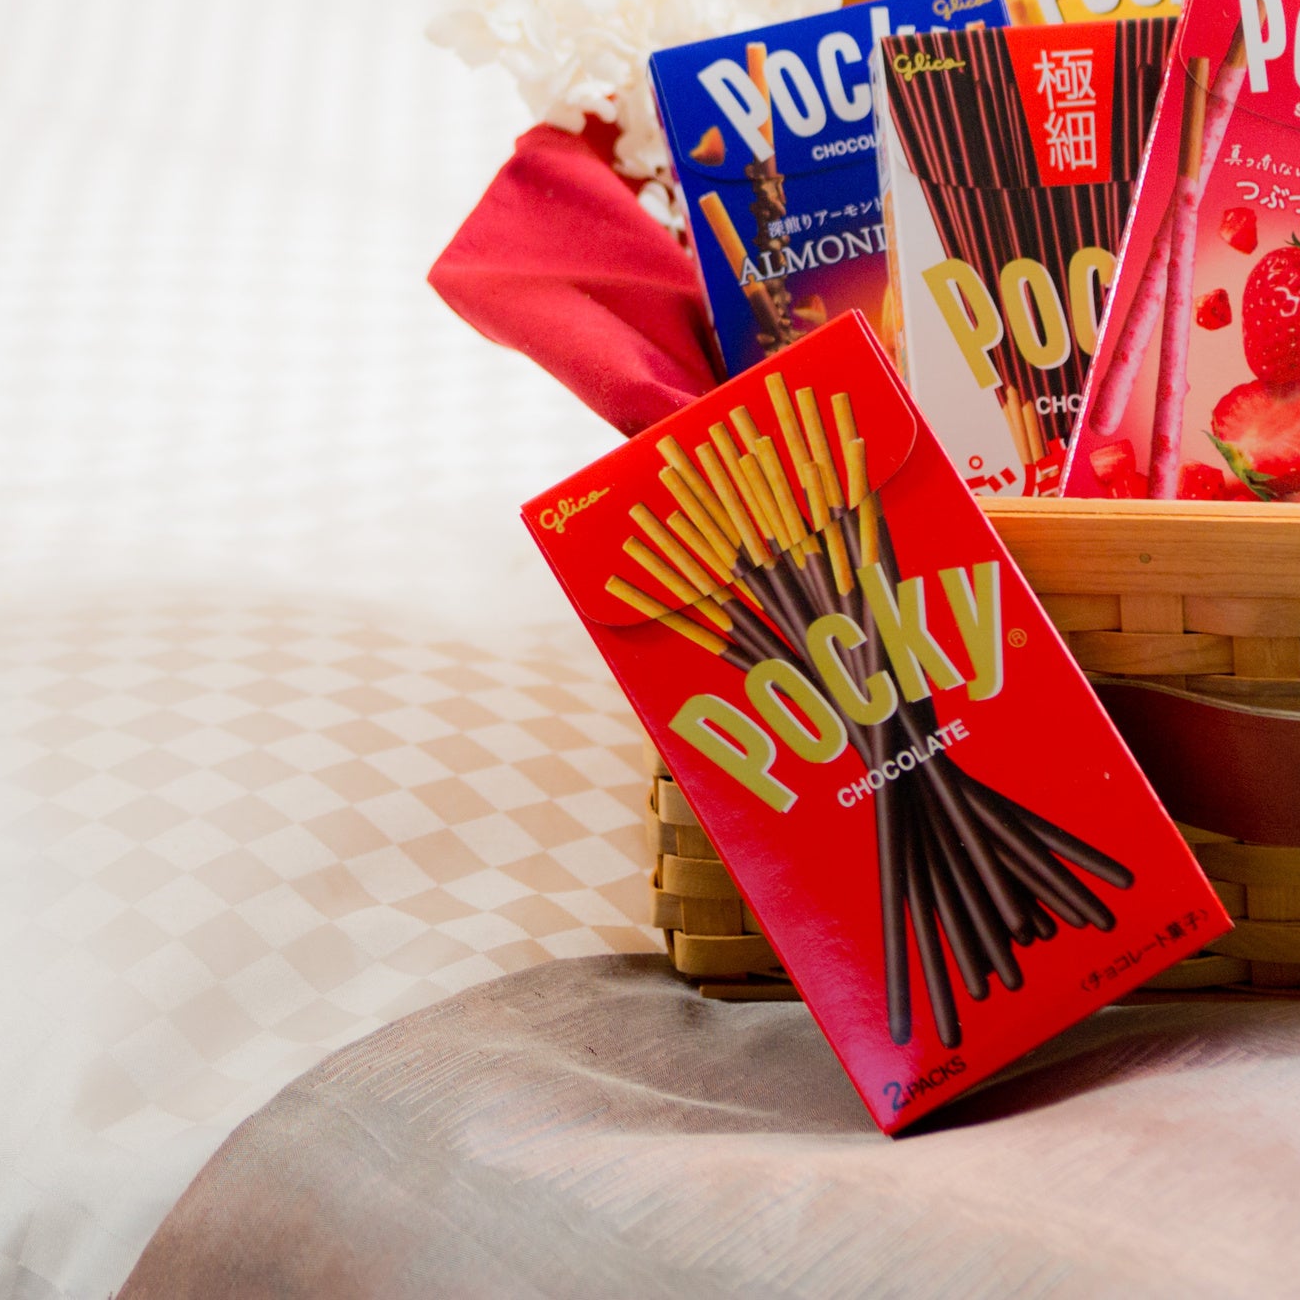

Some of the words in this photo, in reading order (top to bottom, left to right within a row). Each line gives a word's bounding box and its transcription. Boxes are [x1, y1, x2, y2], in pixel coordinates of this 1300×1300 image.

[697, 6, 950, 163] Poc
[893, 52, 966, 82] Glico
[1033, 48, 1098, 172] 極細
[538, 486, 611, 534] Glico
[667, 560, 1004, 814] Pocky
[836, 718, 971, 808] CHOCOLATE
[882, 1080, 911, 1113] 2
[905, 1054, 968, 1101] PACKS
